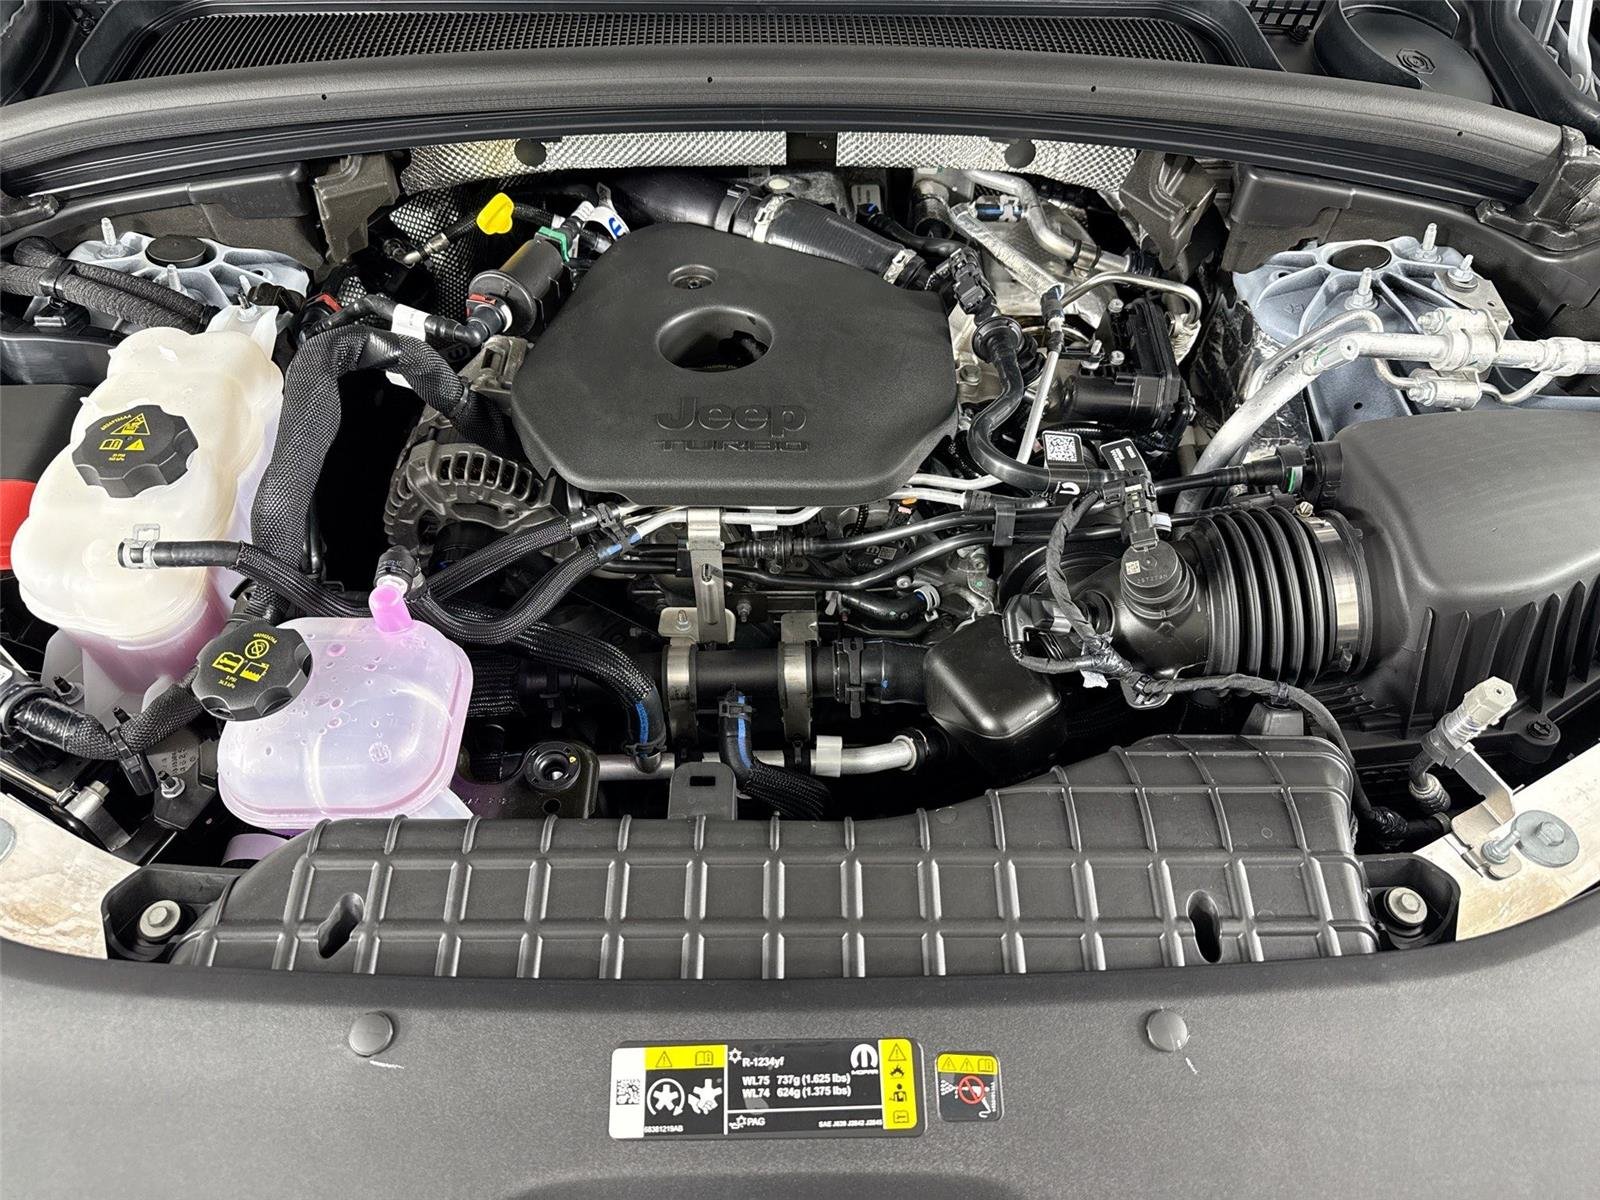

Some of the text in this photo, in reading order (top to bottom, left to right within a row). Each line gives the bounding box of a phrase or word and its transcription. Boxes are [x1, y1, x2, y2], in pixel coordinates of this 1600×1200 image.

[655, 398, 807, 439] Jeep
[652, 440, 809, 452] TURBO
[742, 1056, 785, 1069] R-1234yf
[742, 1072, 851, 1087] WL75 737g (1.625 lbs)
[742, 1085, 852, 1099] WL74 624g (1.375 lbs)
[746, 1117, 766, 1127] PAG
